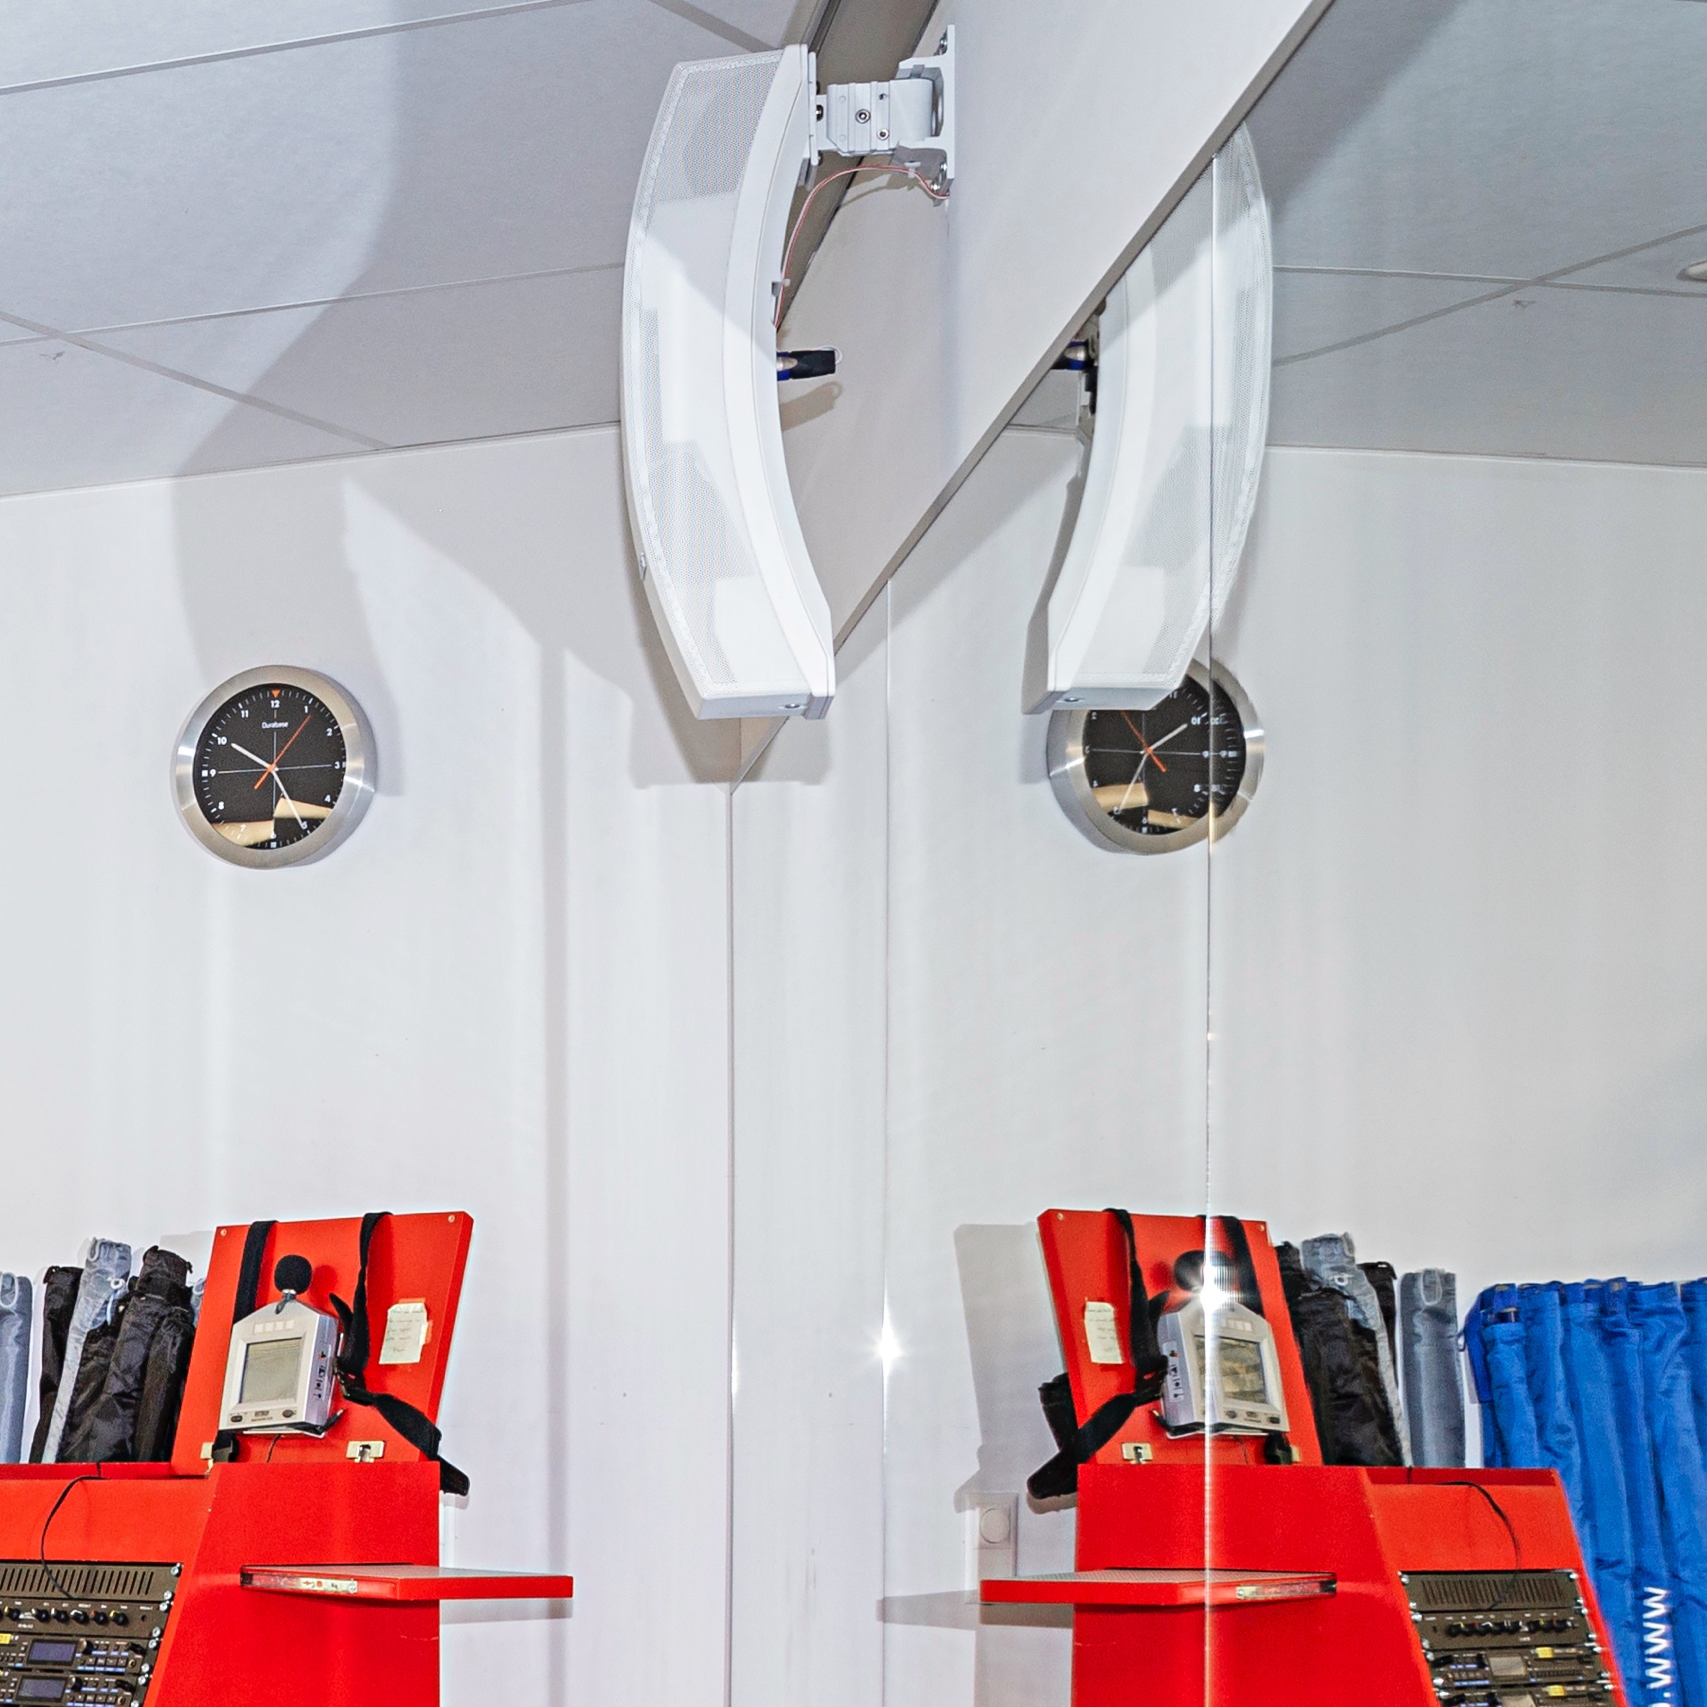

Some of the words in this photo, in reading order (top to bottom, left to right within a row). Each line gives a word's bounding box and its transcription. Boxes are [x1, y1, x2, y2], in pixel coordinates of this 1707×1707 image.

[270, 700, 280, 708] 12
[240, 710, 249, 718] 11
[326, 728, 333, 736] 2
[217, 737, 227, 745] 10
[209, 769, 216, 777] 9
[218, 801, 225, 810] 8
